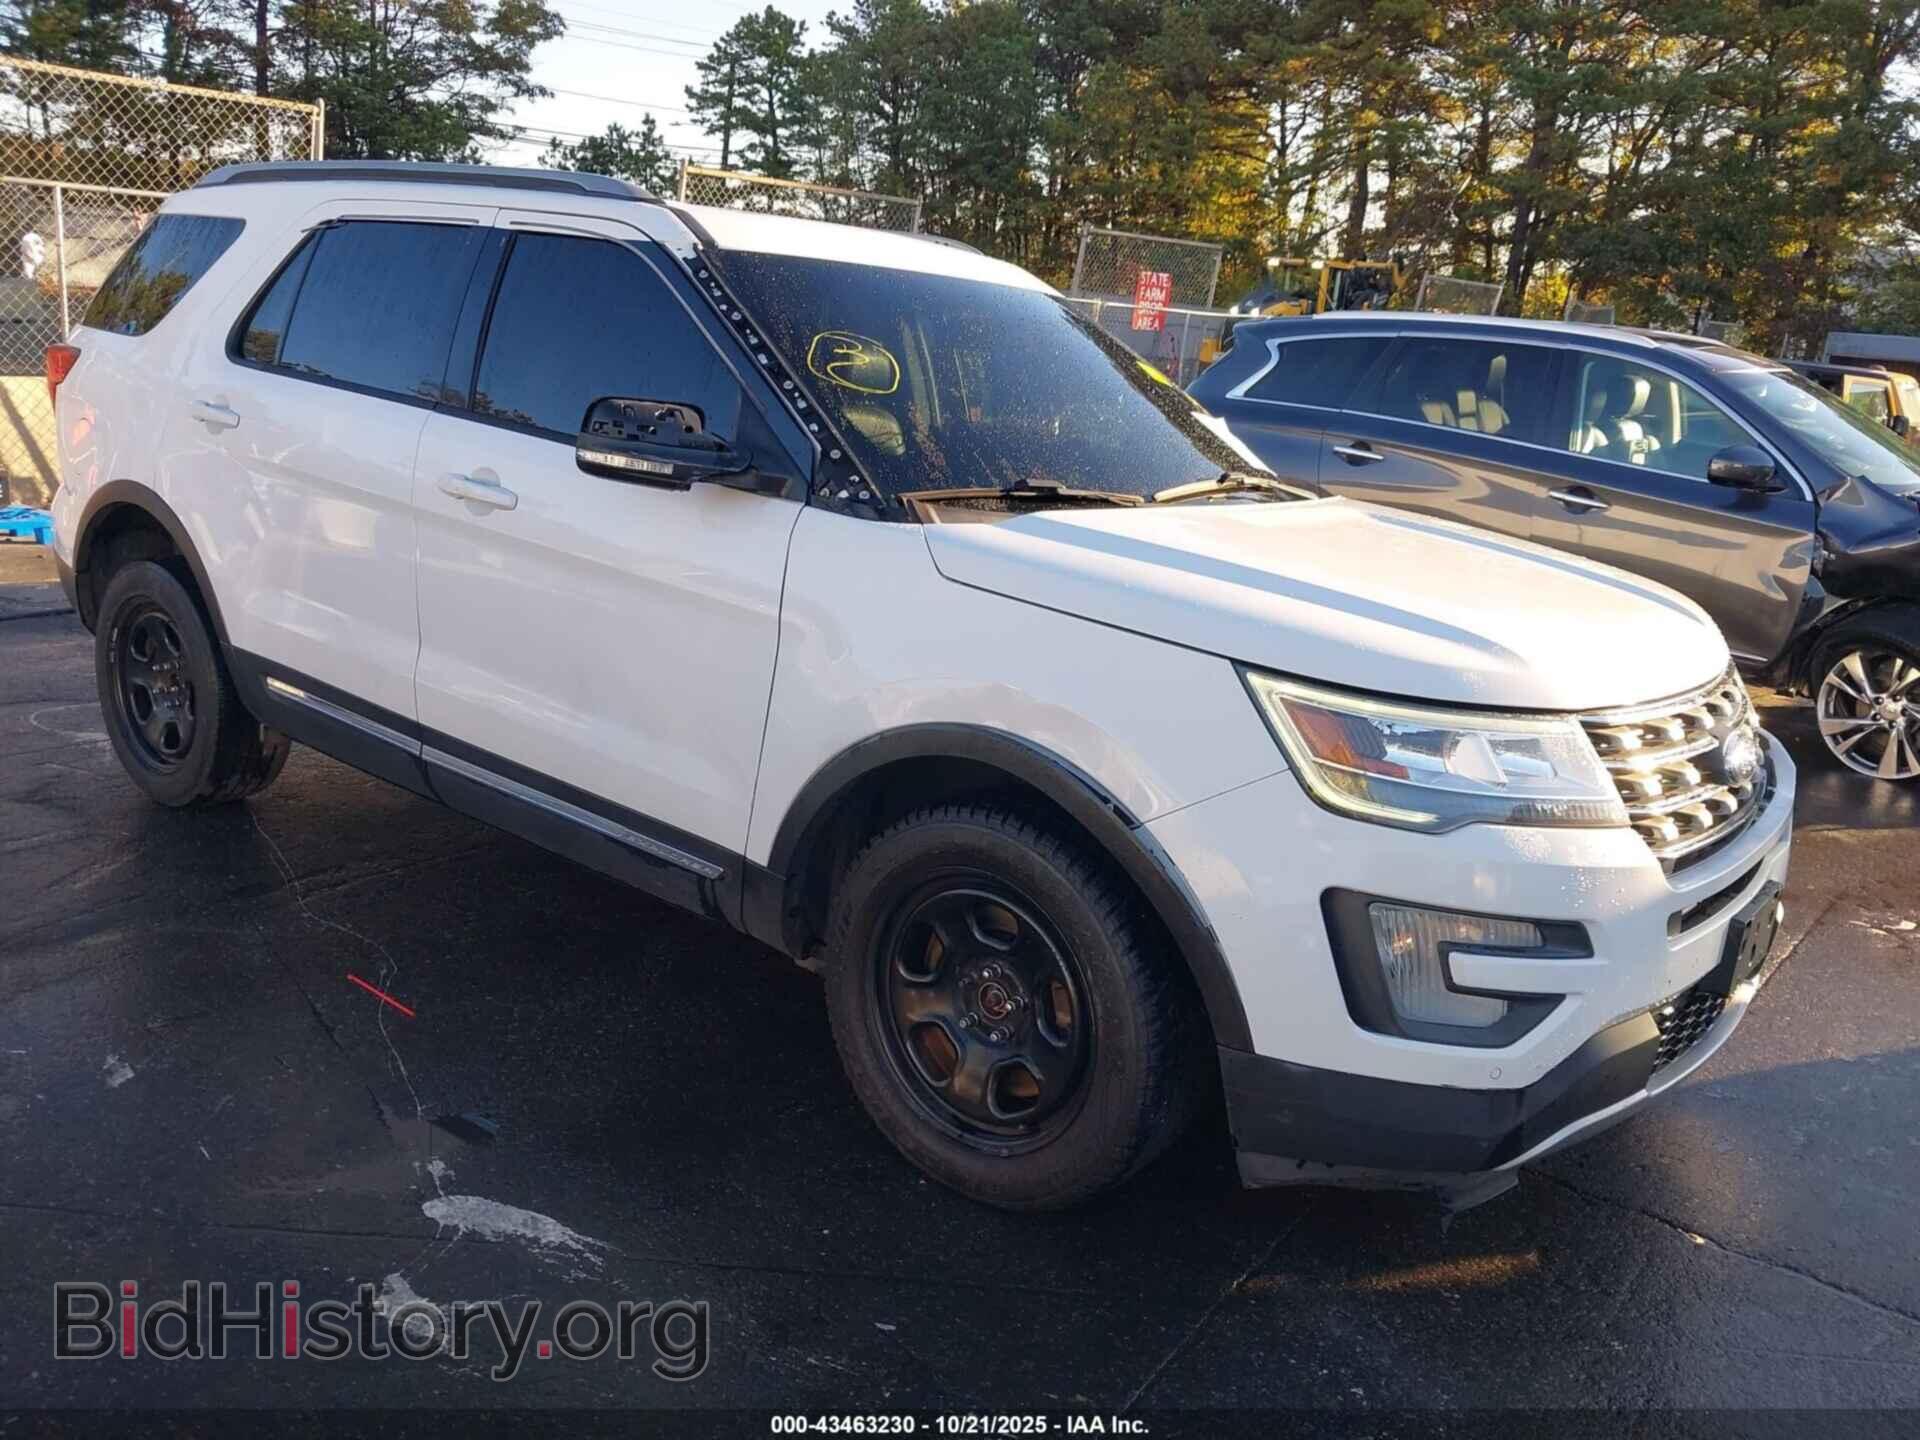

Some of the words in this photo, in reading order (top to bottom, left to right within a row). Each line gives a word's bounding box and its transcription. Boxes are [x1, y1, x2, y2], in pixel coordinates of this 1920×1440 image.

[1140, 271, 1170, 287] STATE
[1139, 286, 1166, 301] FARM
[1134, 316, 1160, 331] AREA
